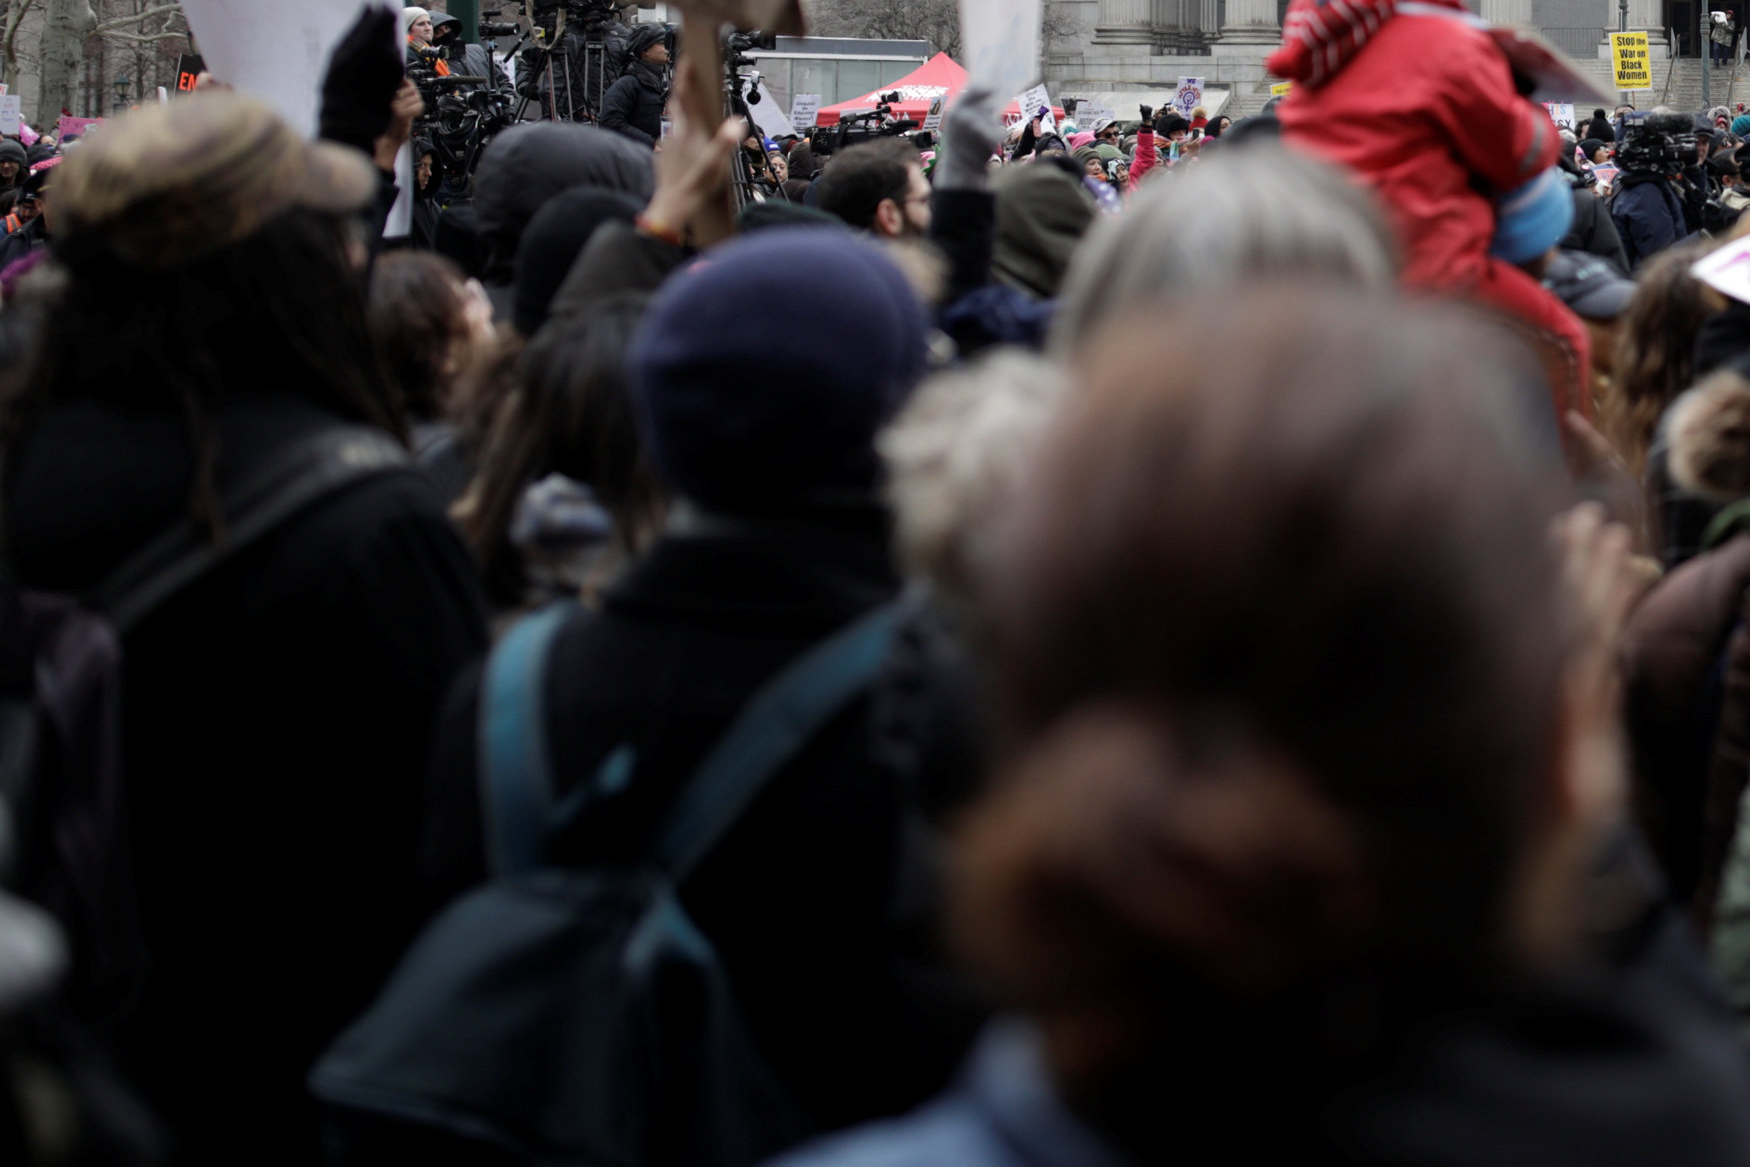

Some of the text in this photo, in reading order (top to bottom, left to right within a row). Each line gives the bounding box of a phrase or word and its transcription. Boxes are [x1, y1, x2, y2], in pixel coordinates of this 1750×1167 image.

[1616, 36, 1635, 46] Stop
[1619, 49, 1646, 59] War on
[1621, 60, 1643, 70] Black
[1617, 71, 1648, 81] Women
